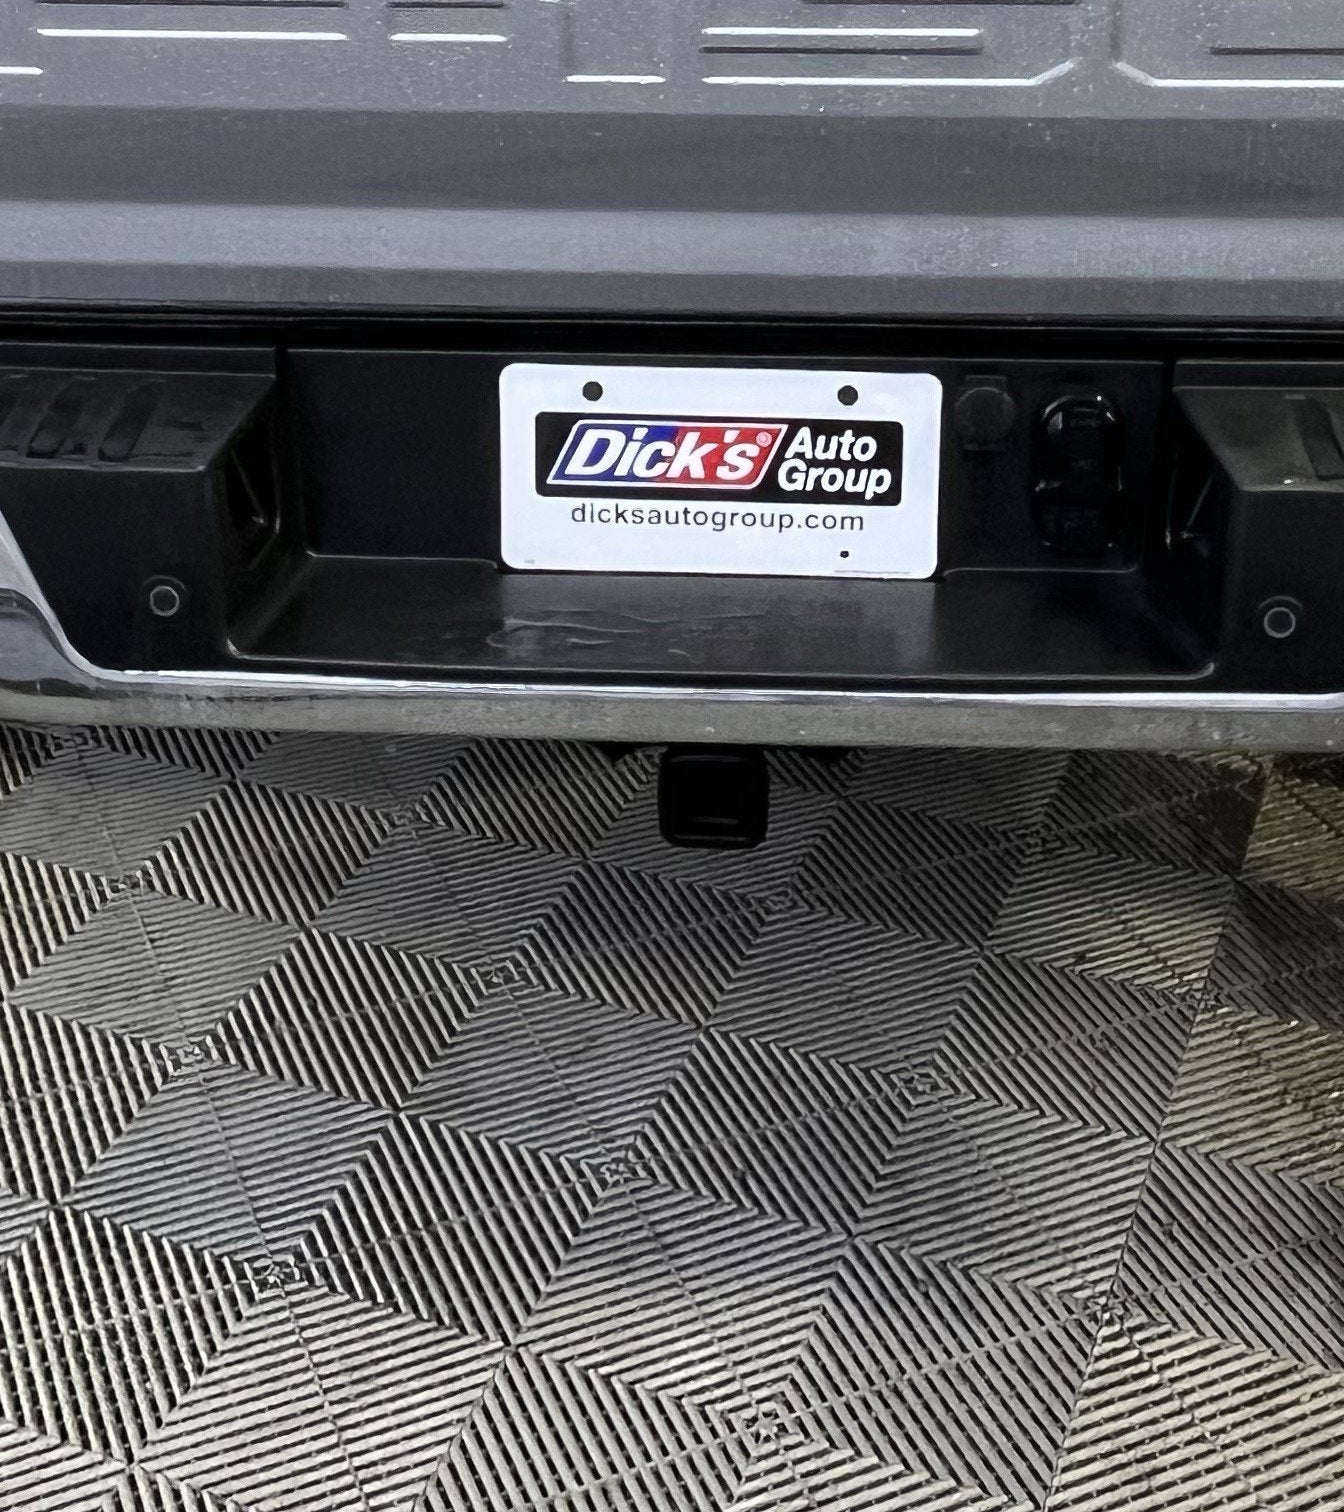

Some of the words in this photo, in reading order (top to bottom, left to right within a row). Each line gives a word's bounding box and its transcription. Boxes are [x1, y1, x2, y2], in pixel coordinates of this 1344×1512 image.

[564, 428, 761, 479] Dick's
[784, 426, 877, 461] Auto
[777, 460, 893, 500] Group
[571, 503, 865, 533] dicksautogroup.com
